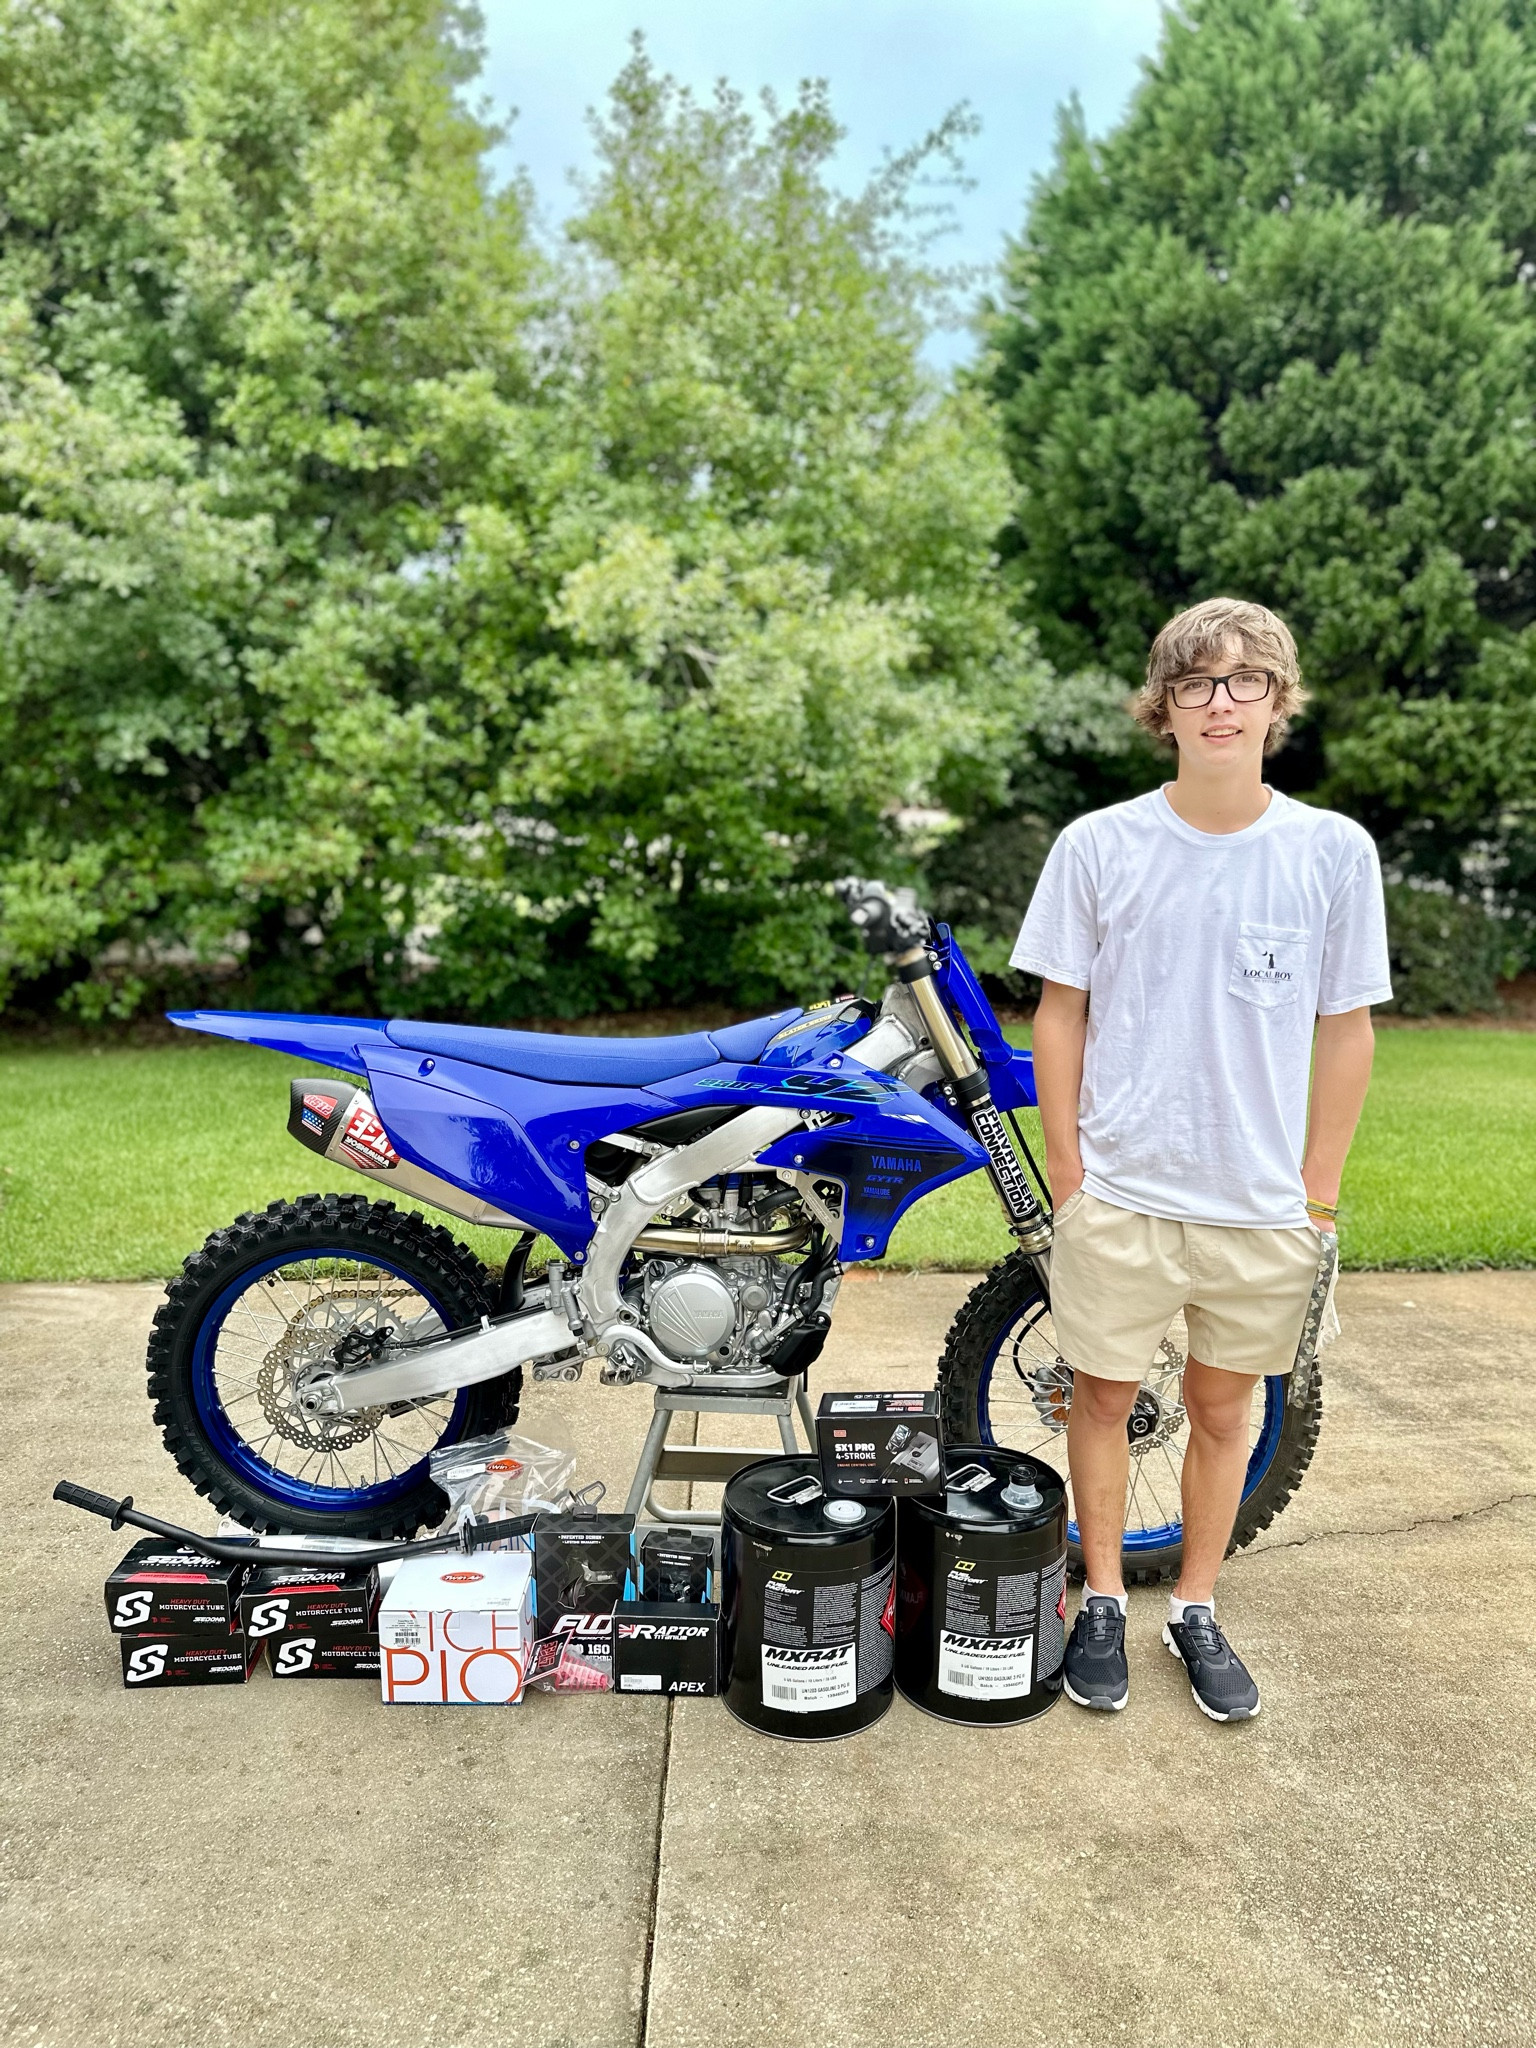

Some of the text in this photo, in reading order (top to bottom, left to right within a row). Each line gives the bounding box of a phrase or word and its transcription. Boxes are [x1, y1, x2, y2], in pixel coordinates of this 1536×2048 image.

[1243, 969, 1293, 980] LOCAL BOY
[344, 1136, 390, 1168] YOSHIMURA
[872, 1155, 922, 1173] YAMAHA
[975, 1112, 1029, 1216] CONNECTION
[987, 1108, 1037, 1210] PRIVATEER
[834, 1443, 876, 1452] SX1 PRO
[835, 1452, 877, 1460] 4-STROKE
[271, 1572, 346, 1584] SEDONA
[948, 1574, 986, 1585] FACTORY
[949, 1570, 971, 1578] FUEL
[765, 1584, 802, 1595] FACTORY
[767, 1580, 788, 1588] FUEL
[113, 1590, 154, 1628] S
[295, 1606, 363, 1617] MOTORCYCLE TUBE
[248, 1598, 290, 1637] S
[330, 1618, 364, 1626] SEDONA
[551, 1614, 613, 1635] FLO
[630, 1624, 710, 1640] RAPTOR
[943, 1633, 1032, 1651] MXR4T
[587, 1644, 611, 1655] 160
[764, 1643, 855, 1663] MXR4T
[944, 1647, 986, 1659] UNLEADED
[174, 1654, 222, 1663] MOTORCYCLE
[275, 1637, 317, 1675] S
[126, 1643, 169, 1682] S
[766, 1661, 808, 1671] UNLEADED
[830, 1660, 849, 1669] FUEL
[208, 1665, 243, 1673] SEDONA
[668, 1681, 706, 1693] APEX
